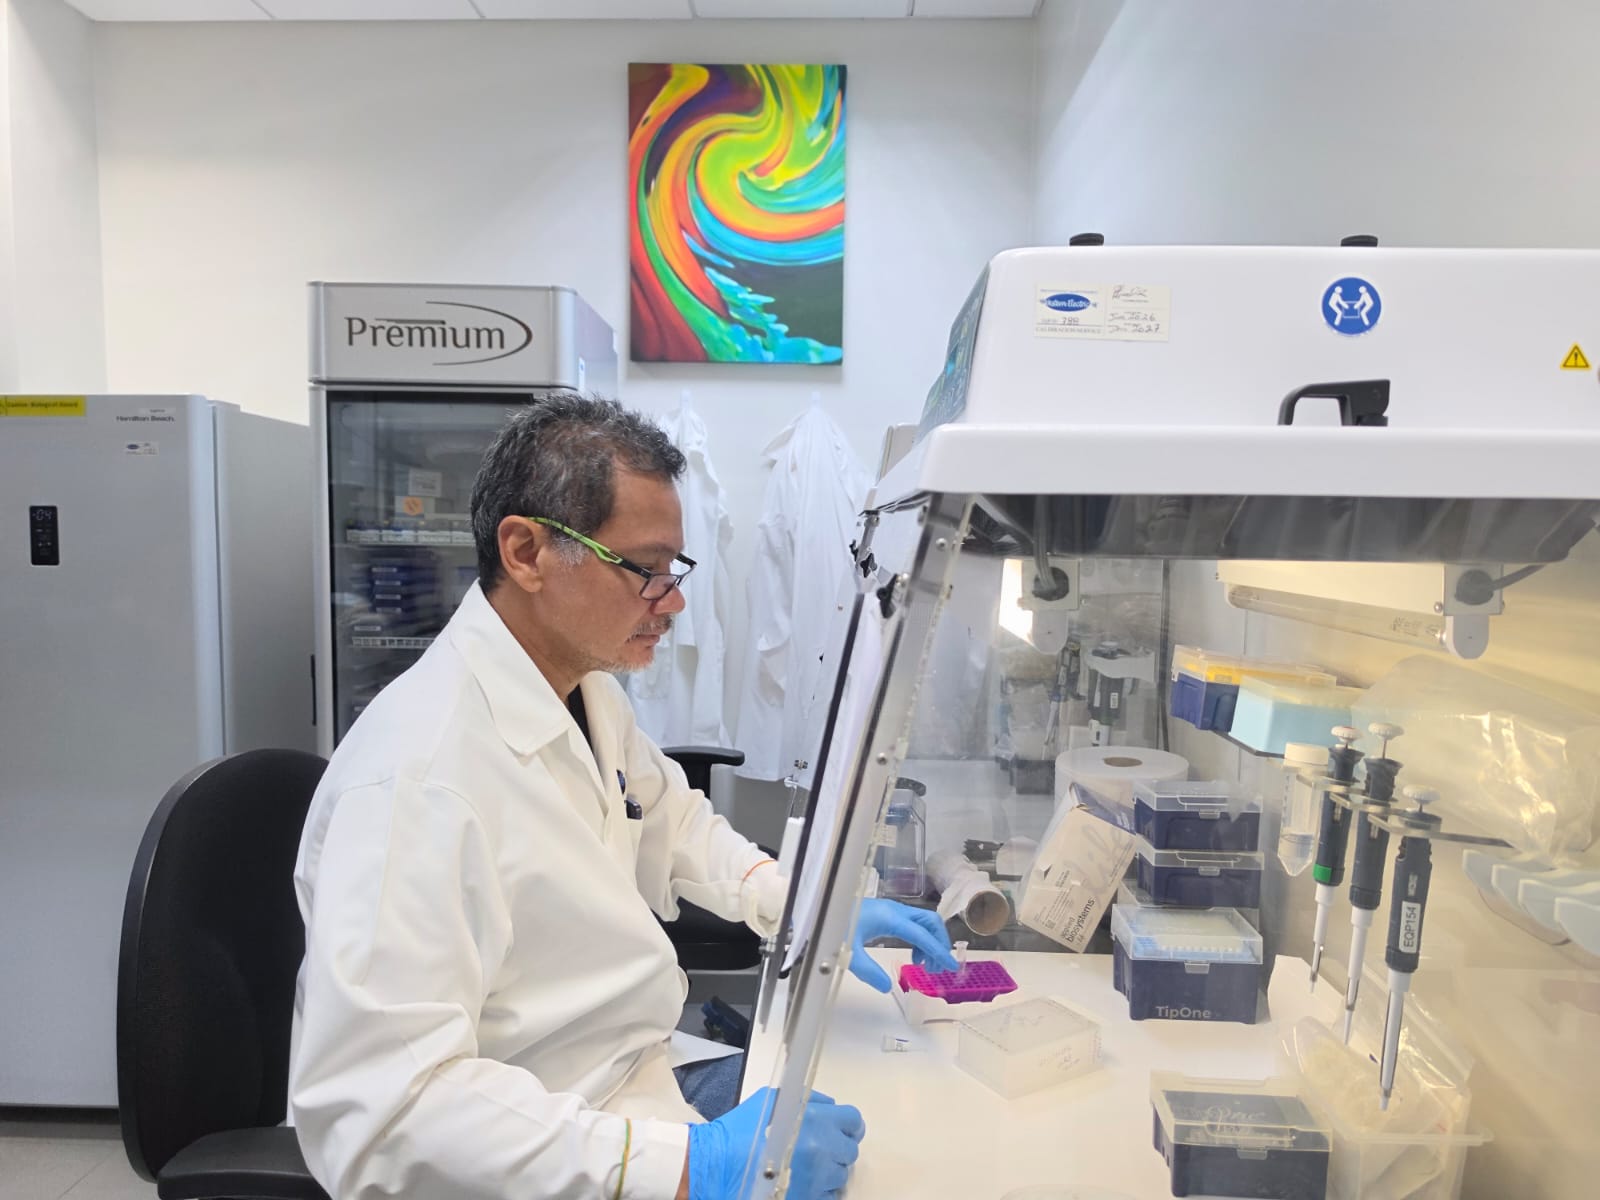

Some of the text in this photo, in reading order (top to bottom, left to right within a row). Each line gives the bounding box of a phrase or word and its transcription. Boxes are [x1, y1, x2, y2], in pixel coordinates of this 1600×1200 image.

[344, 317, 505, 350] Premium
[1065, 899, 1095, 943] biosystems
[1403, 906, 1417, 948] EQP154
[1155, 1005, 1212, 1020] TipOne
